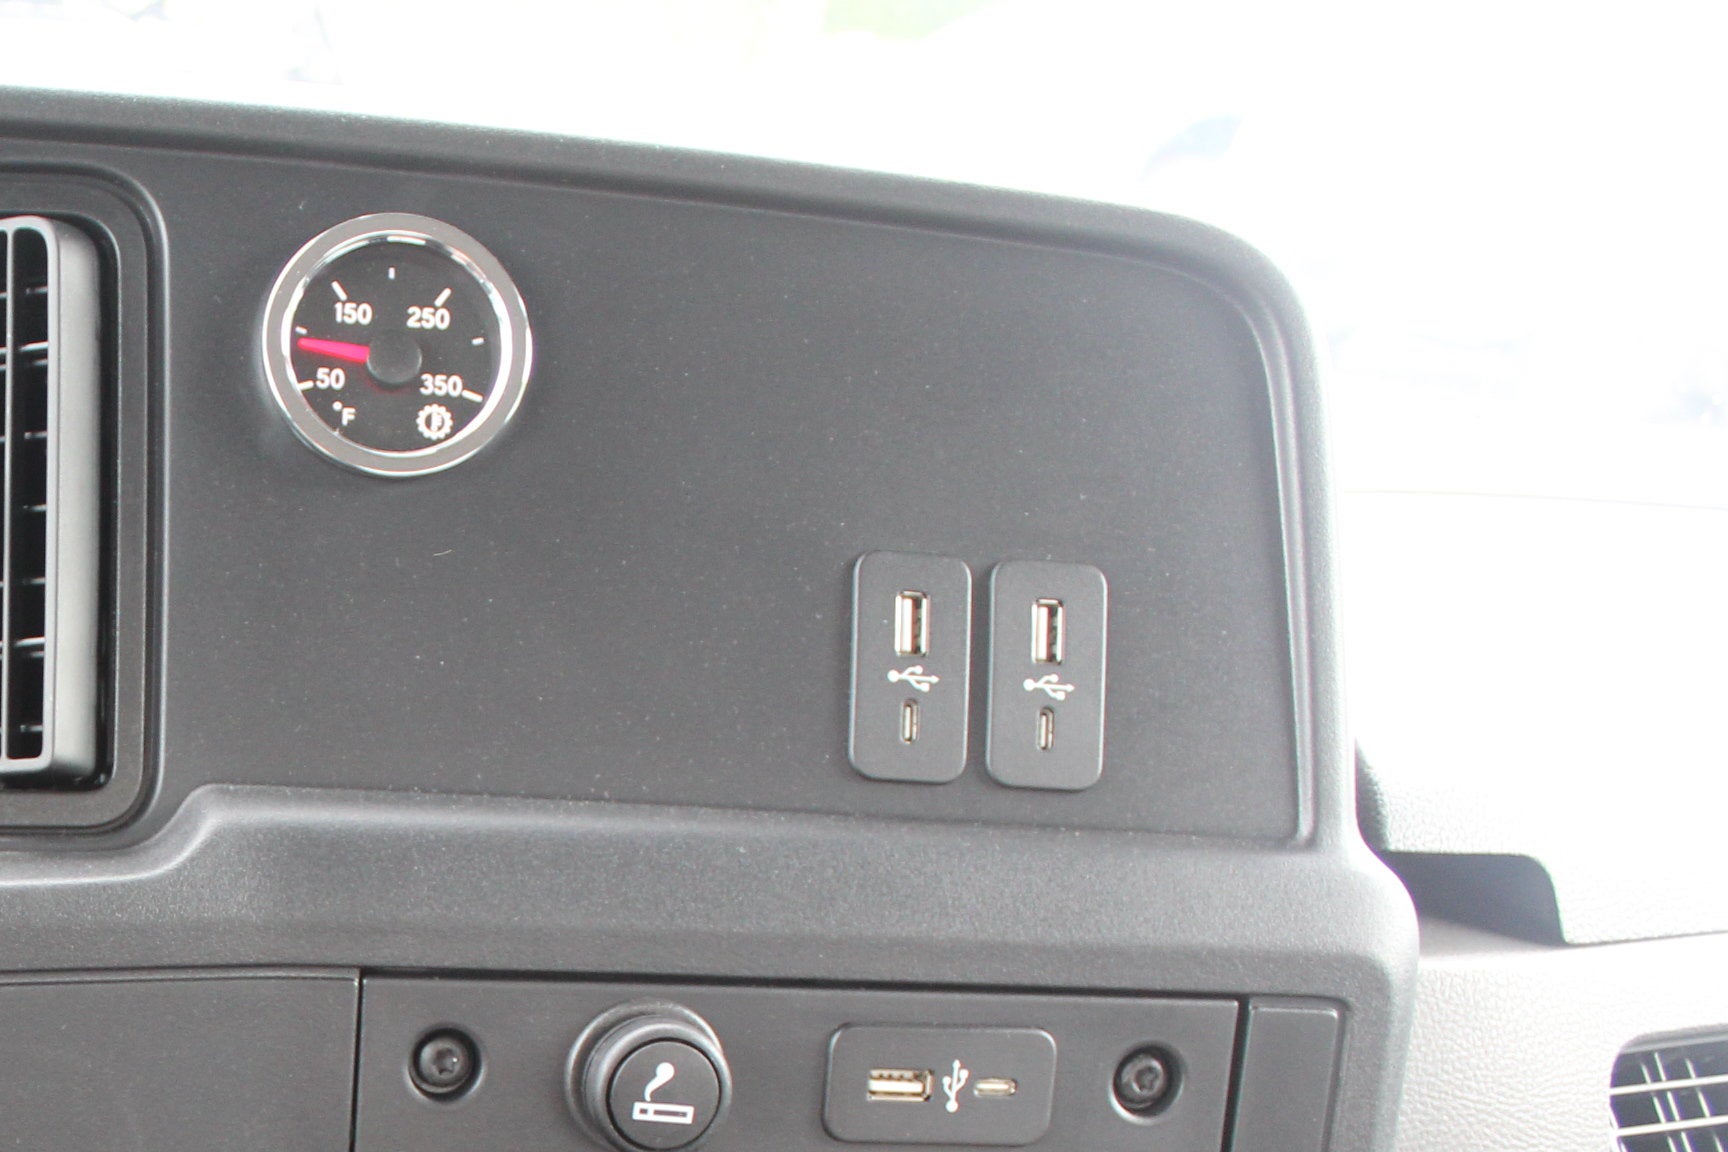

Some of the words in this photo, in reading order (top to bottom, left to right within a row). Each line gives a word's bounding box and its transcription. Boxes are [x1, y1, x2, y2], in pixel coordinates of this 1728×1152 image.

[335, 302, 372, 324] 150
[407, 305, 450, 329] 250
[316, 368, 345, 389] 50
[420, 374, 463, 396] 350
